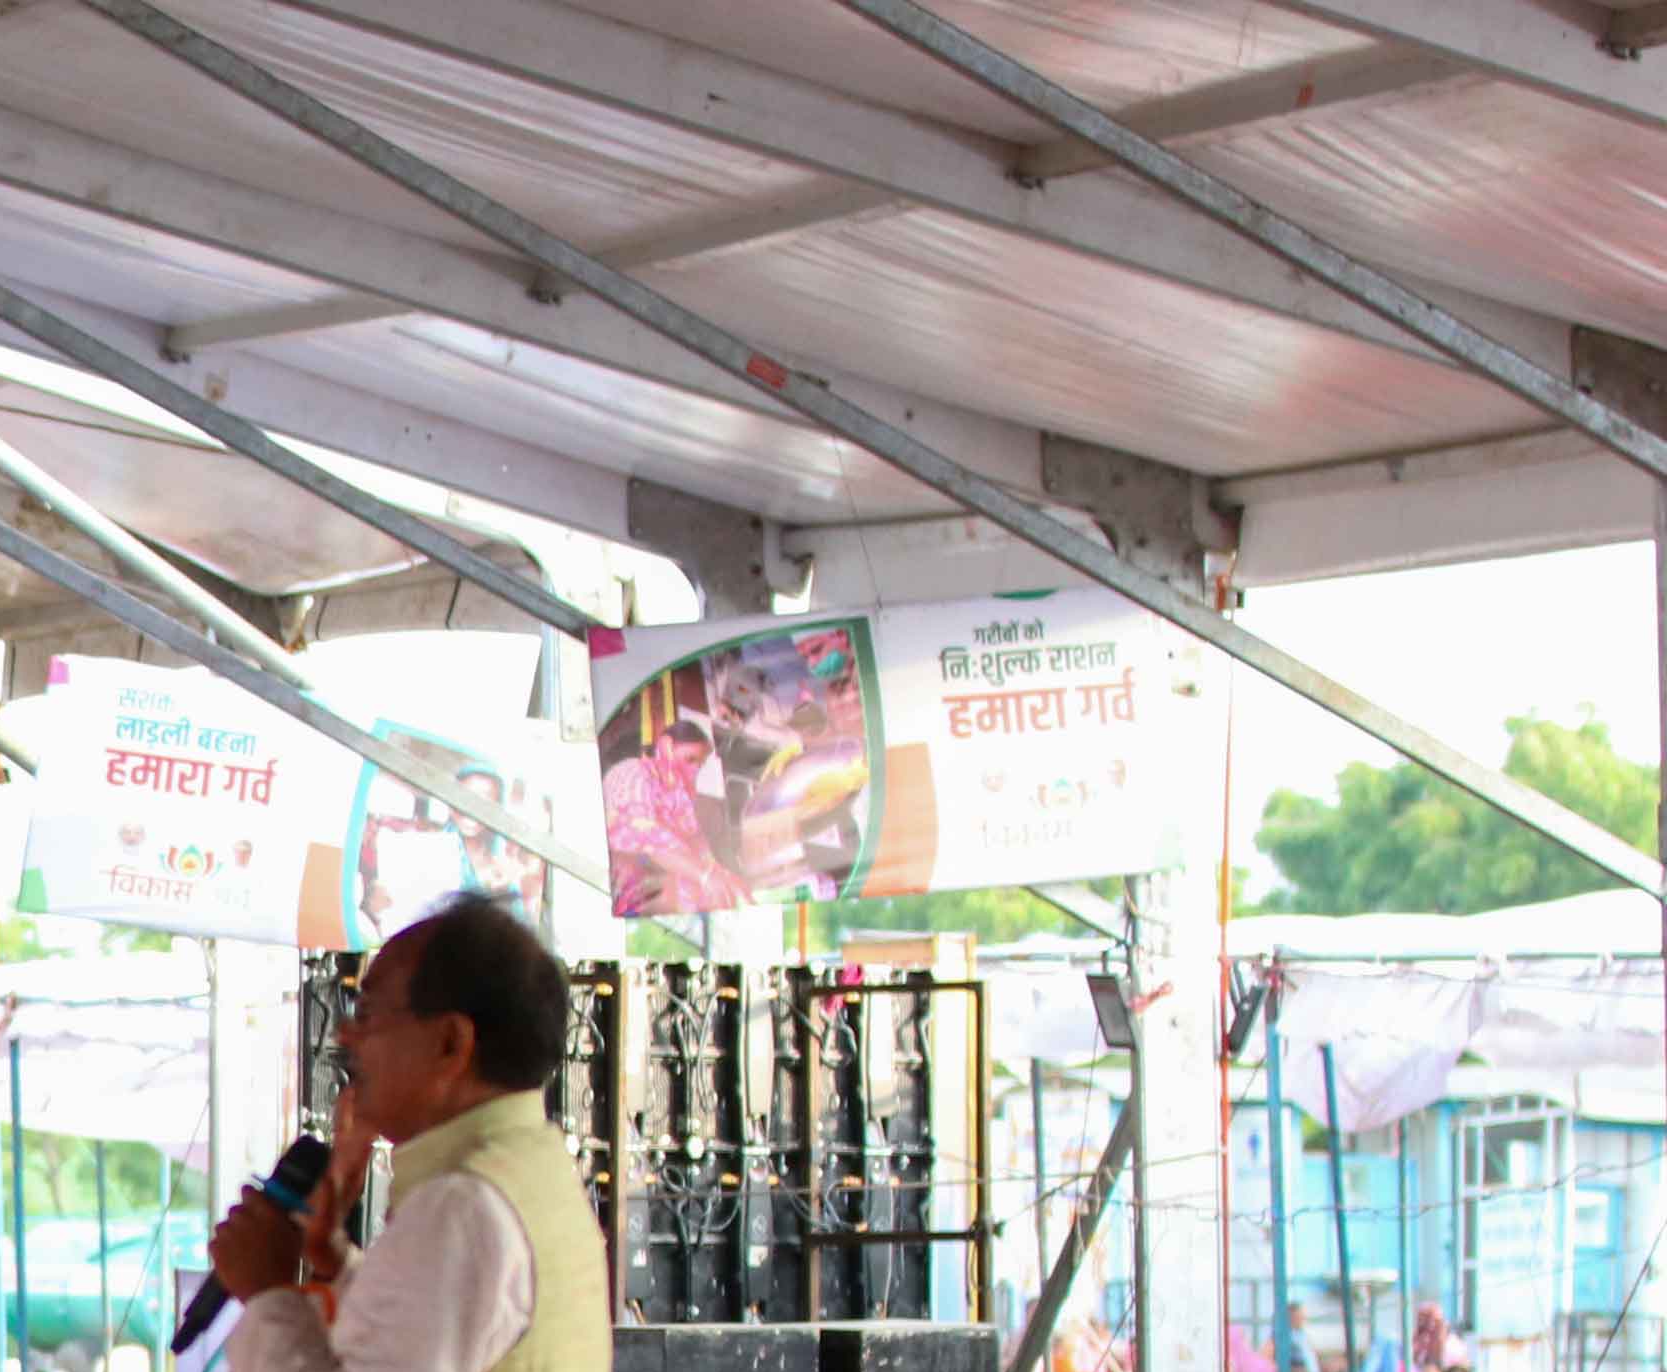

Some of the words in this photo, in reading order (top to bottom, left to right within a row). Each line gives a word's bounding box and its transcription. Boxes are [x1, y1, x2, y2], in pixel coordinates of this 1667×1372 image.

[1024, 617, 1044, 641] को
[1048, 641, 1116, 672] राशन
[942, 686, 1067, 740] हमारा
[1073, 665, 1137, 724] गर्व
[106, 748, 213, 797] हमारा
[222, 759, 279, 807] गर्व
